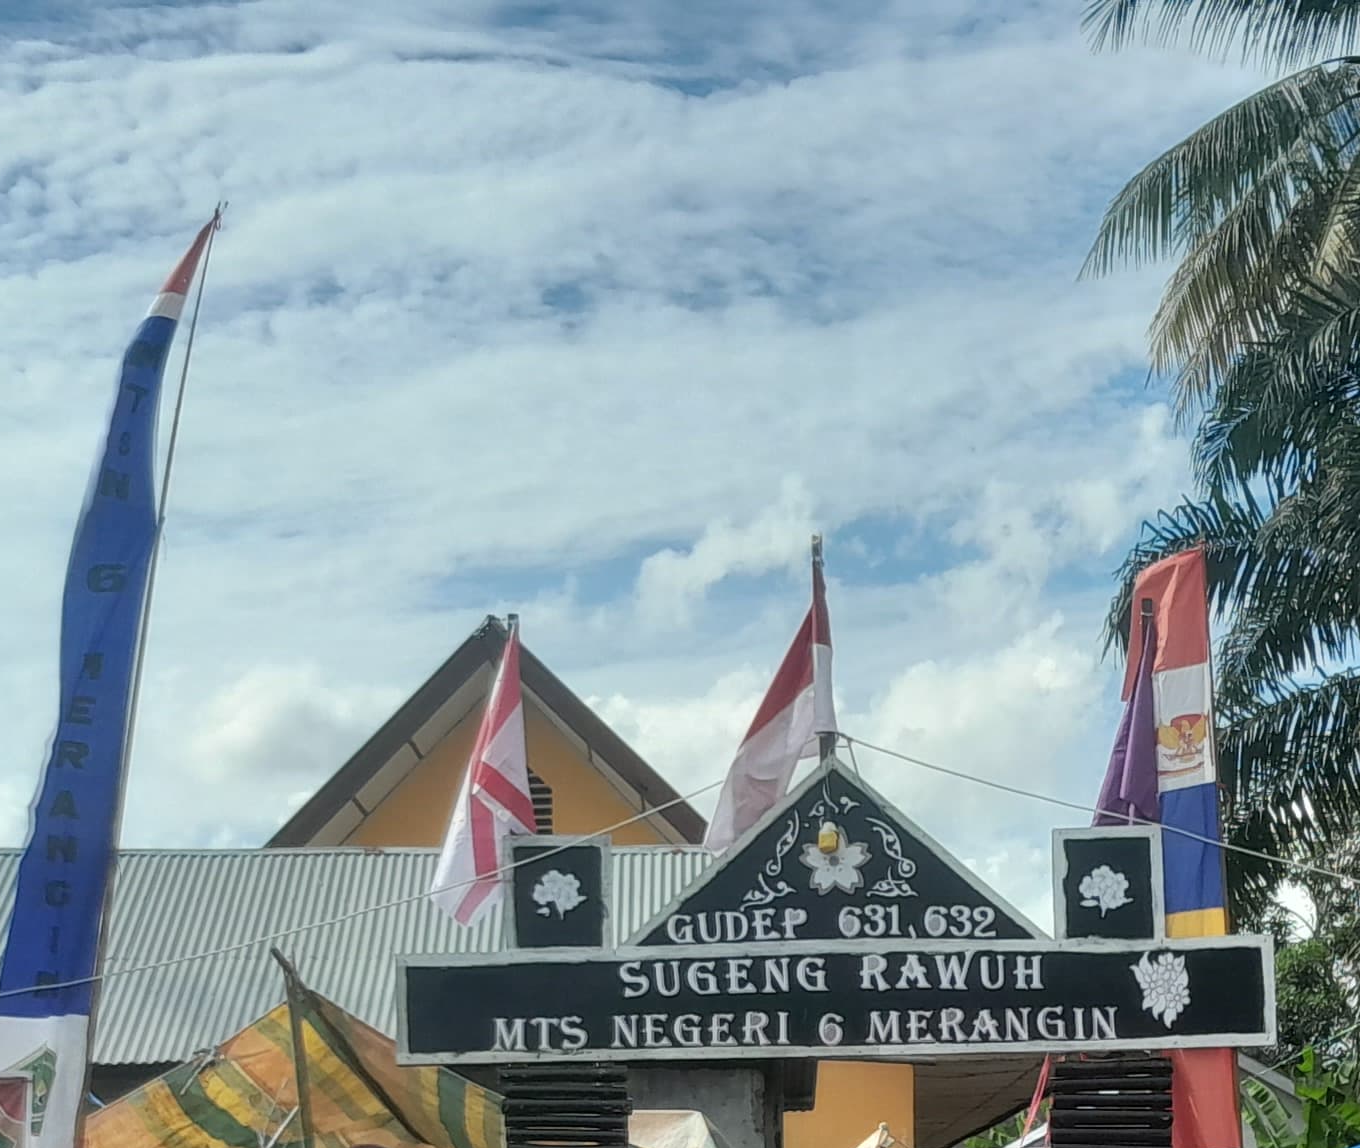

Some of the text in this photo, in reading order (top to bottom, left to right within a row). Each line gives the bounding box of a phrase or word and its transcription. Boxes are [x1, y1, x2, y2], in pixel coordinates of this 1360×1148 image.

[87, 563, 128, 593] 6
[667, 907, 808, 944] GUDEP
[619, 950, 1045, 998] SUGENG RAWUH
[491, 1005, 1119, 1051] MTS NEGERI 6 MERANGIN
